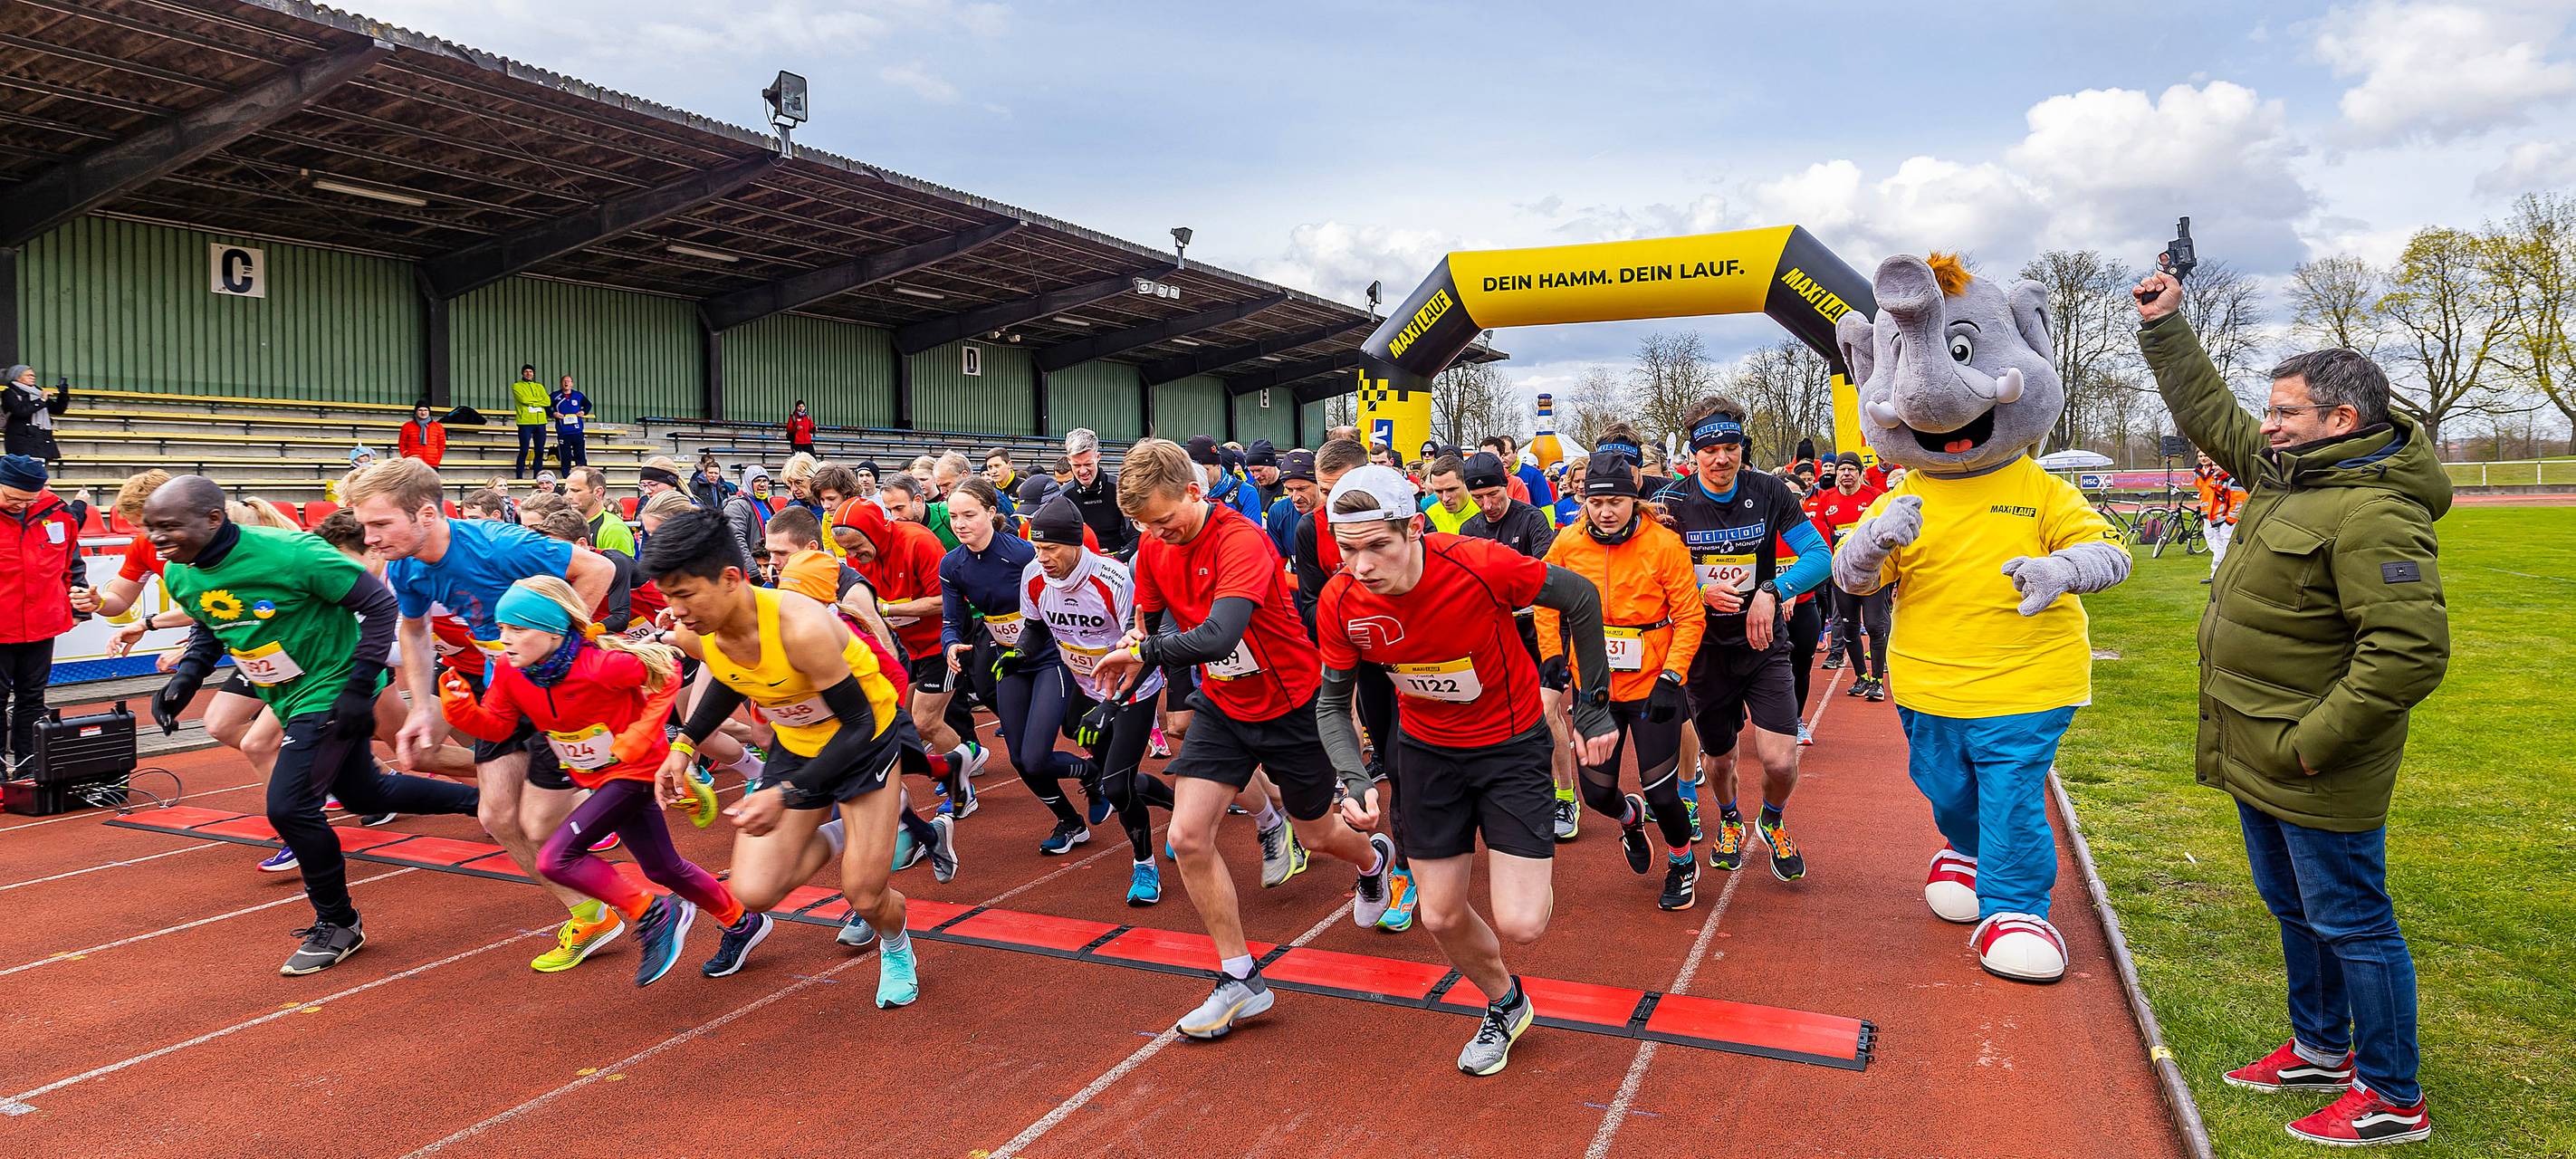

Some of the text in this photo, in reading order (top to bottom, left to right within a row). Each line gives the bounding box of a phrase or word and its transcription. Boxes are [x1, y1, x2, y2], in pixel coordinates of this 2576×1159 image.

[222, 248, 254, 293] C
[1482, 259, 1746, 292] DEIN HAMM. DEIN LAUF.
[1780, 266, 1827, 304] MAXi
[1387, 291, 1449, 359] MAXi LAUF
[966, 348, 978, 373] D
[1261, 389, 1268, 406] E
[1990, 504, 2036, 518] MAXi LAUF
[1689, 524, 1764, 542] WEICON
[1707, 567, 1743, 580] 460
[1046, 610, 1106, 627] VATRO
[994, 623, 1020, 636] 468
[1605, 640, 1626, 655] 31
[1069, 654, 1094, 666] 451
[1407, 679, 1460, 693] 1122
